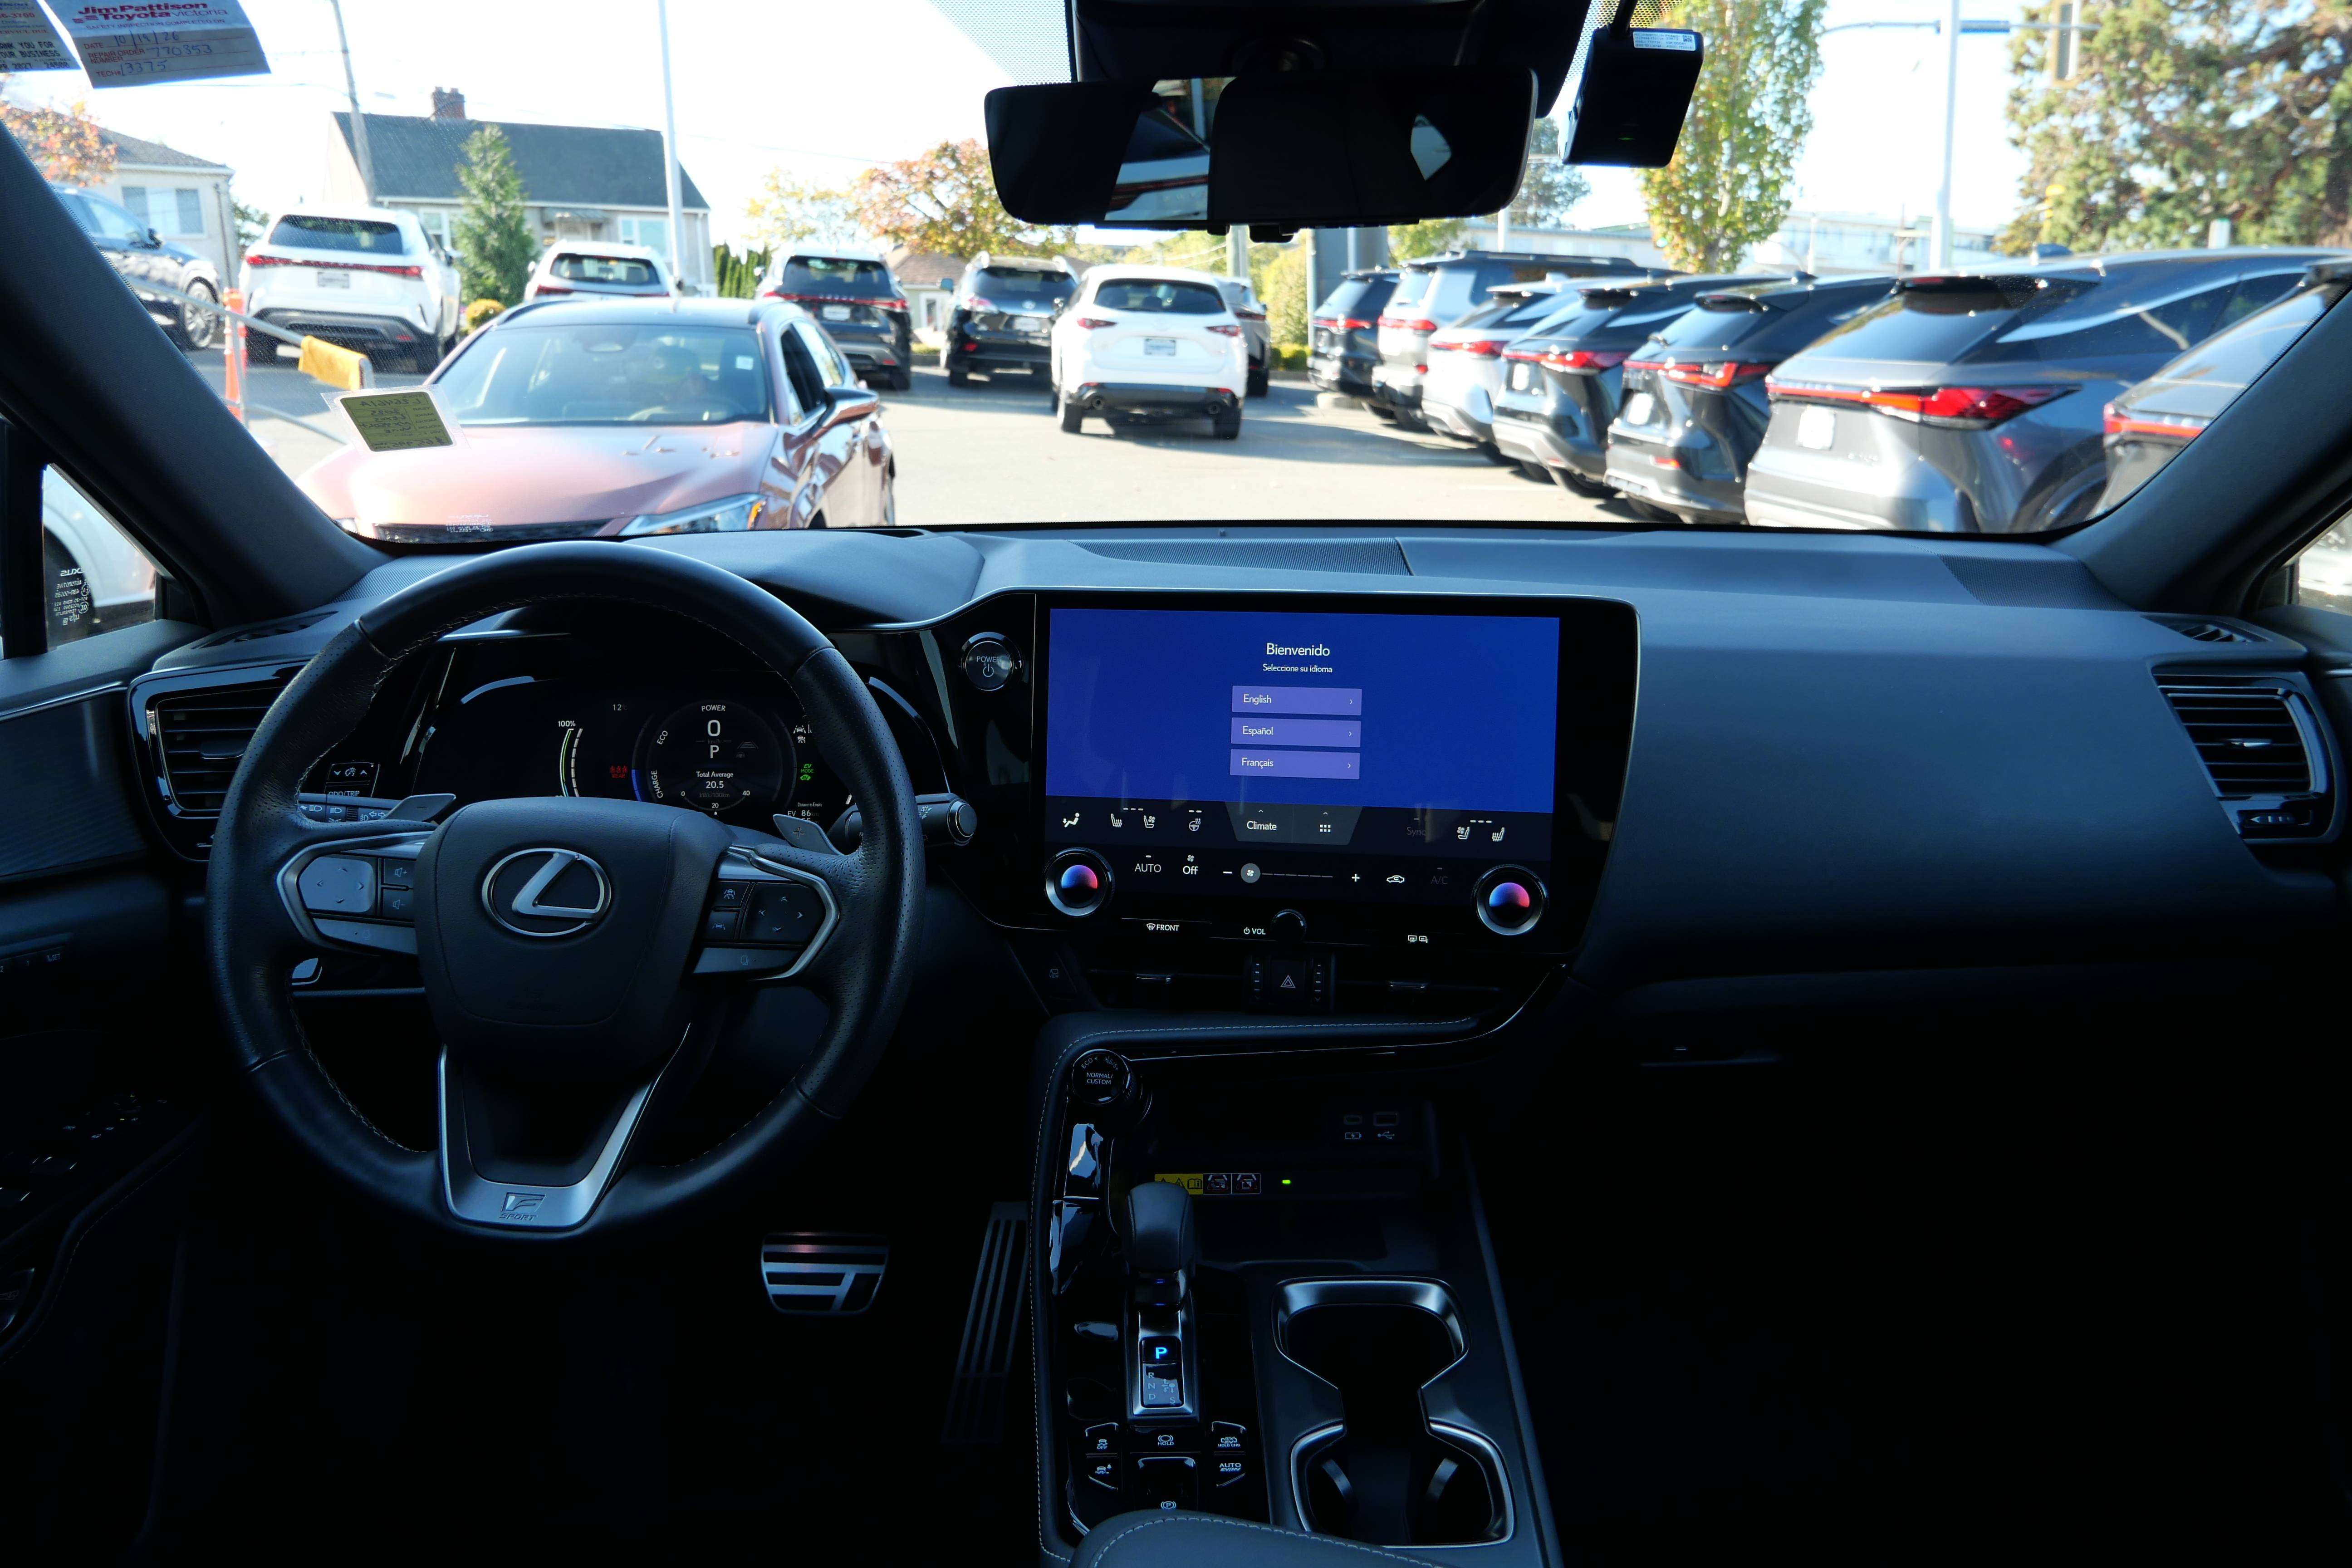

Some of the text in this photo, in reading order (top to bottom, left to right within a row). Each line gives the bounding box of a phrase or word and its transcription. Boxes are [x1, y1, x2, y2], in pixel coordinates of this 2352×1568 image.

[78, 3, 208, 15] Jim Pattison
[99, 8, 229, 21] Toyota victoria
[87, 49, 146, 59] REPAIR ORDER
[1266, 642, 1330, 656] Bienvenido
[1263, 663, 1298, 672] Seleccione
[1309, 665, 1333, 673] idioma
[1243, 694, 1272, 705] English
[1242, 725, 1274, 737] Español
[657, 730, 668, 745] ECO
[710, 745, 720, 759] P
[1241, 757, 1274, 769] Français
[651, 770, 664, 799] CHARGE
[706, 780, 724, 789] 20.5
[1246, 820, 1277, 831] Climate
[1406, 826, 1426, 838] Sync
[1134, 863, 1161, 872] AUTO
[1182, 866, 1199, 875] Off
[1430, 875, 1449, 885] A/C
[1081, 1058, 1093, 1069] ECO
[499, 1213, 537, 1221] SPORT
[1155, 1347, 1167, 1359] P
